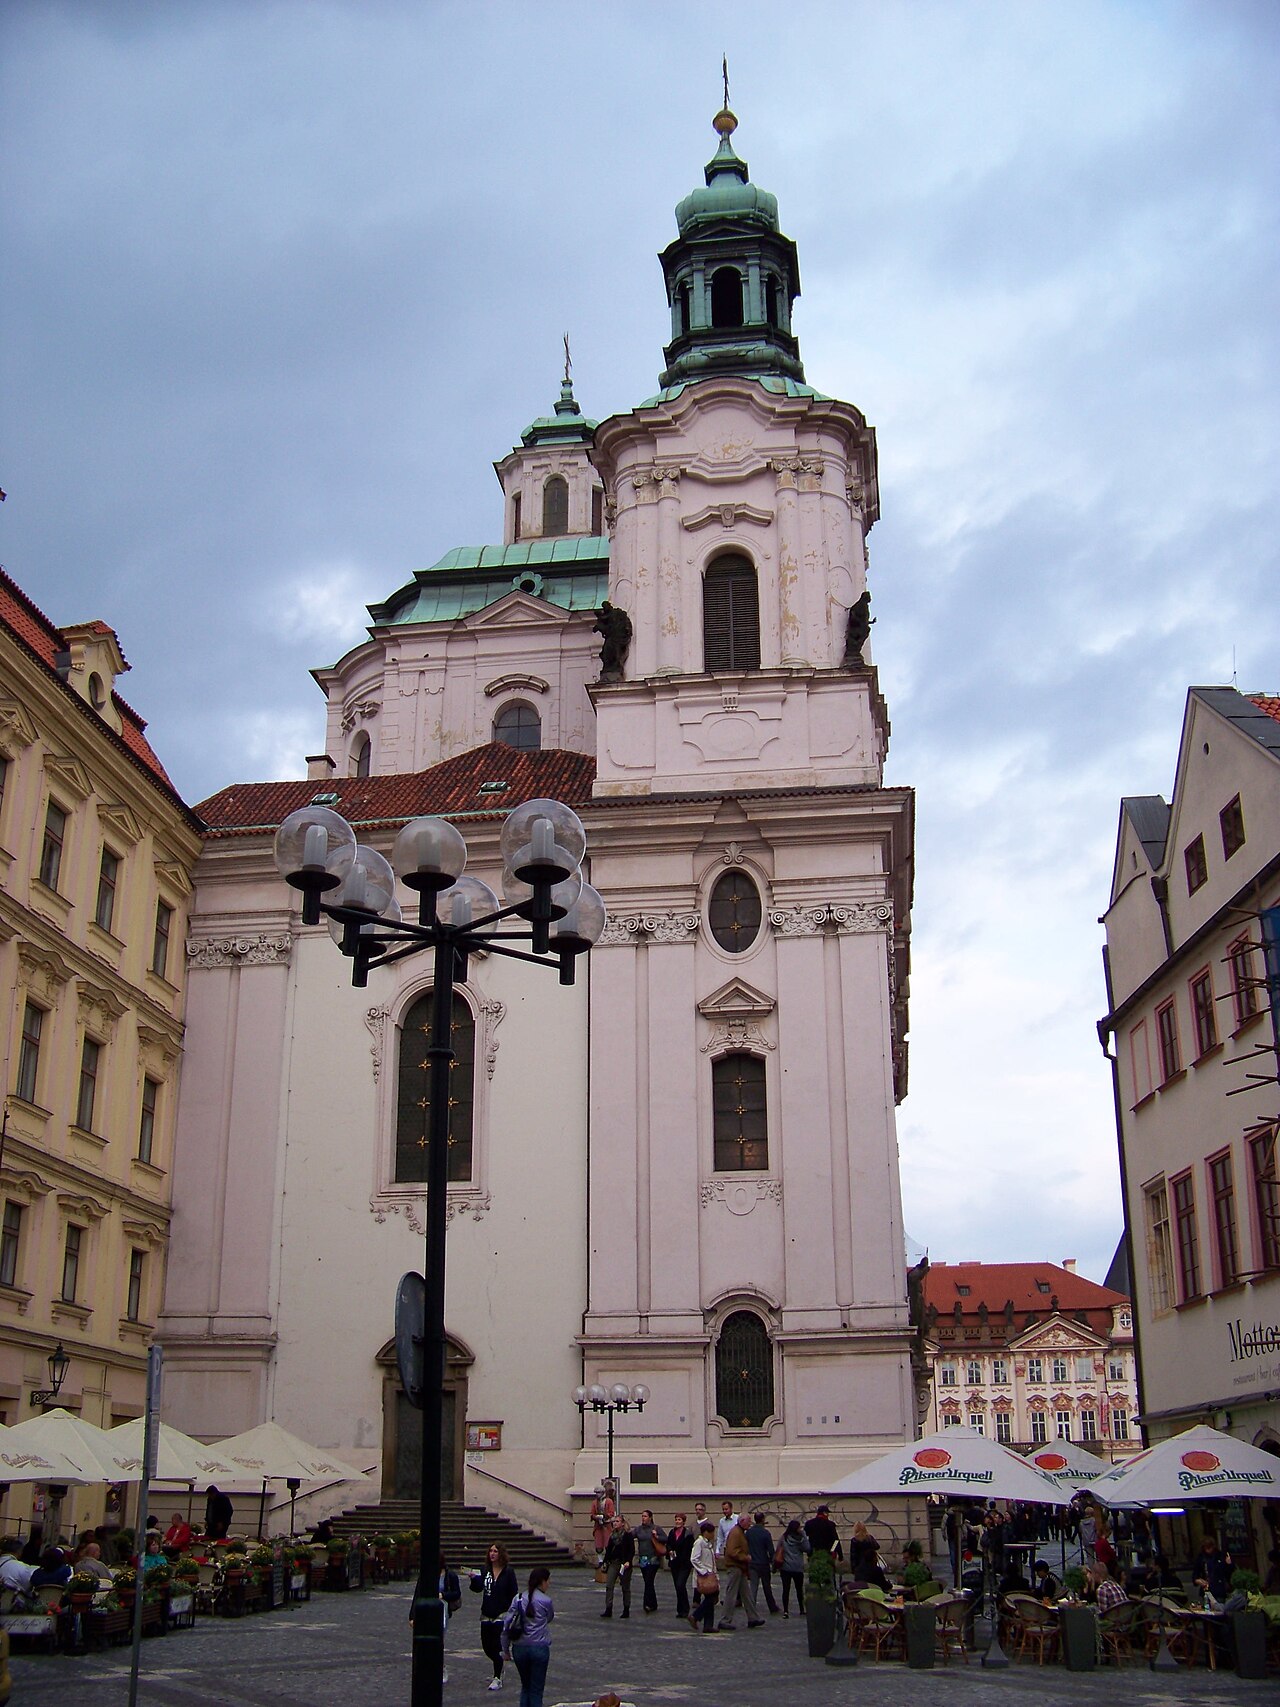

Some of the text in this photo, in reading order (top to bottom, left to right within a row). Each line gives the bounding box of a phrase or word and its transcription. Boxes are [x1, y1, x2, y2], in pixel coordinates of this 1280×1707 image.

[899, 1467, 992, 1485] Pilsner Urquell
[1178, 1469, 1272, 1490] Pilsner Urquell
